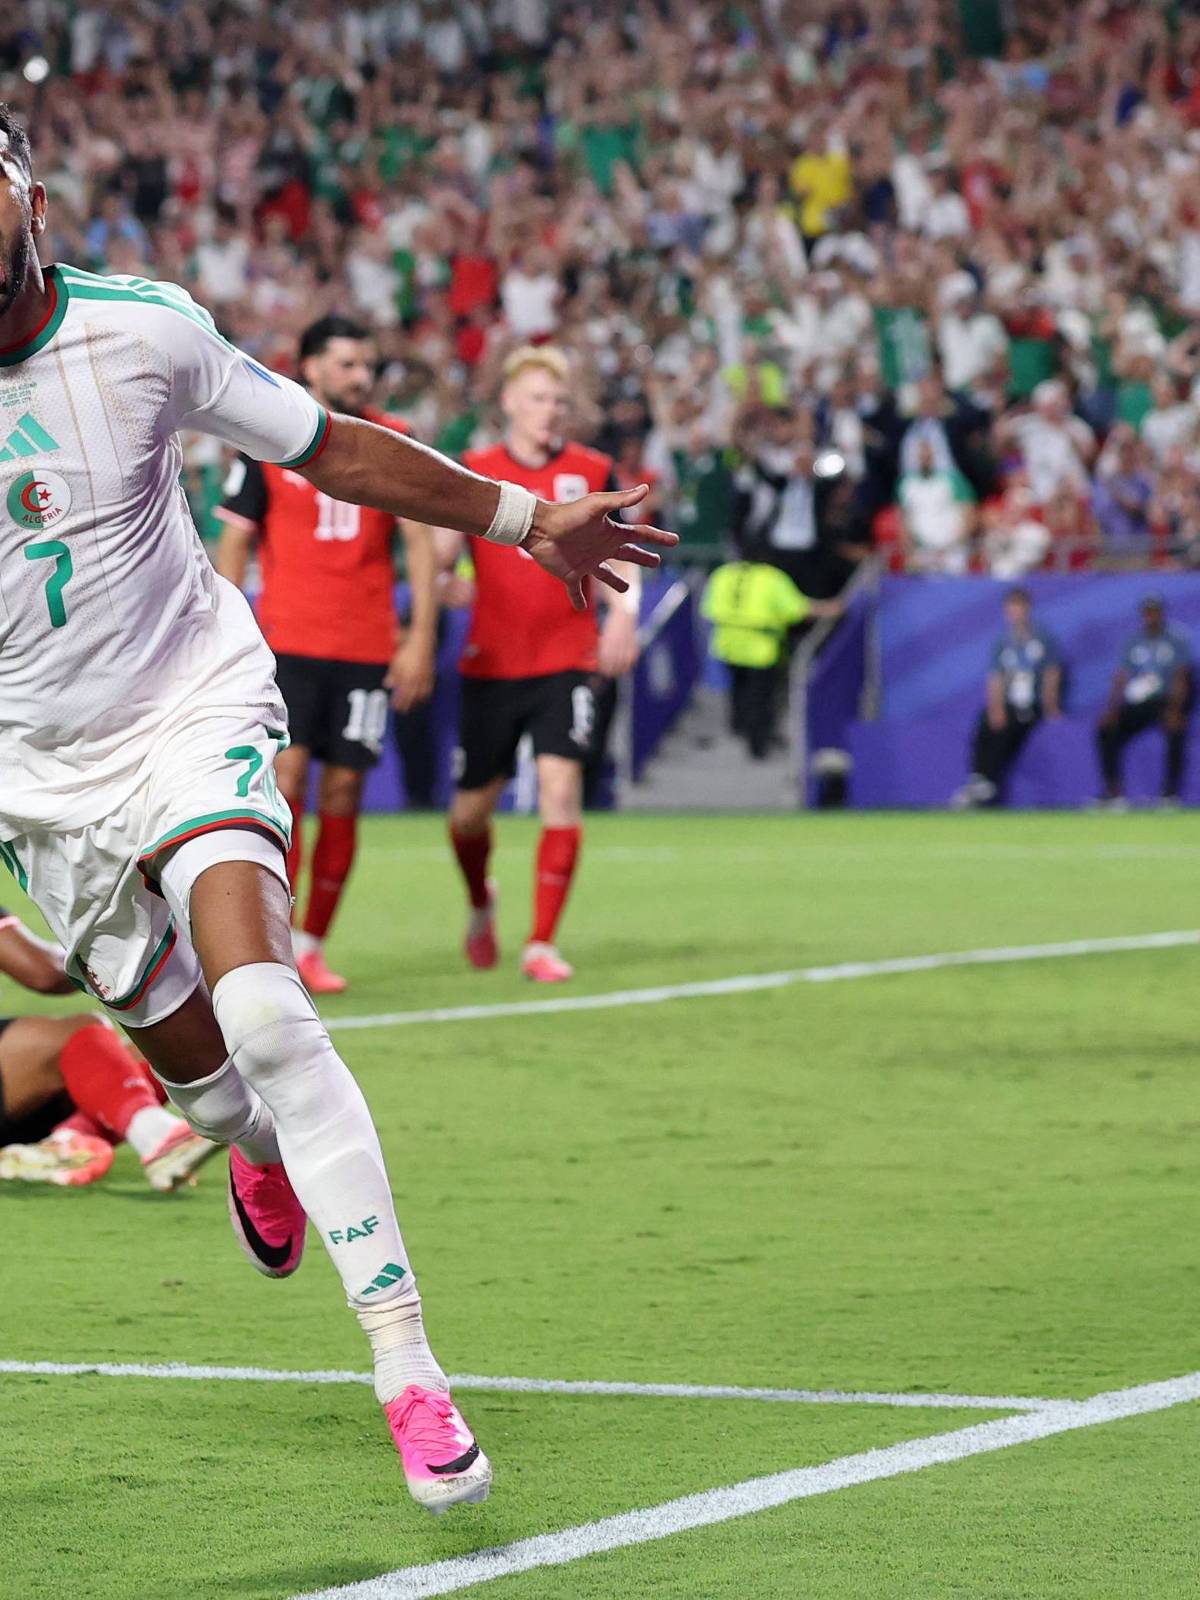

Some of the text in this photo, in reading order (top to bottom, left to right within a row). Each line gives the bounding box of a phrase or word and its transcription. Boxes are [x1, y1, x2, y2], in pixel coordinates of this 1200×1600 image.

[22, 507, 63, 523] ALGERIA
[314, 491, 360, 541] 10
[24, 540, 73, 628] 7
[342, 688, 387, 740] 10
[224, 745, 263, 797] 7
[328, 1215, 379, 1245] FAF
